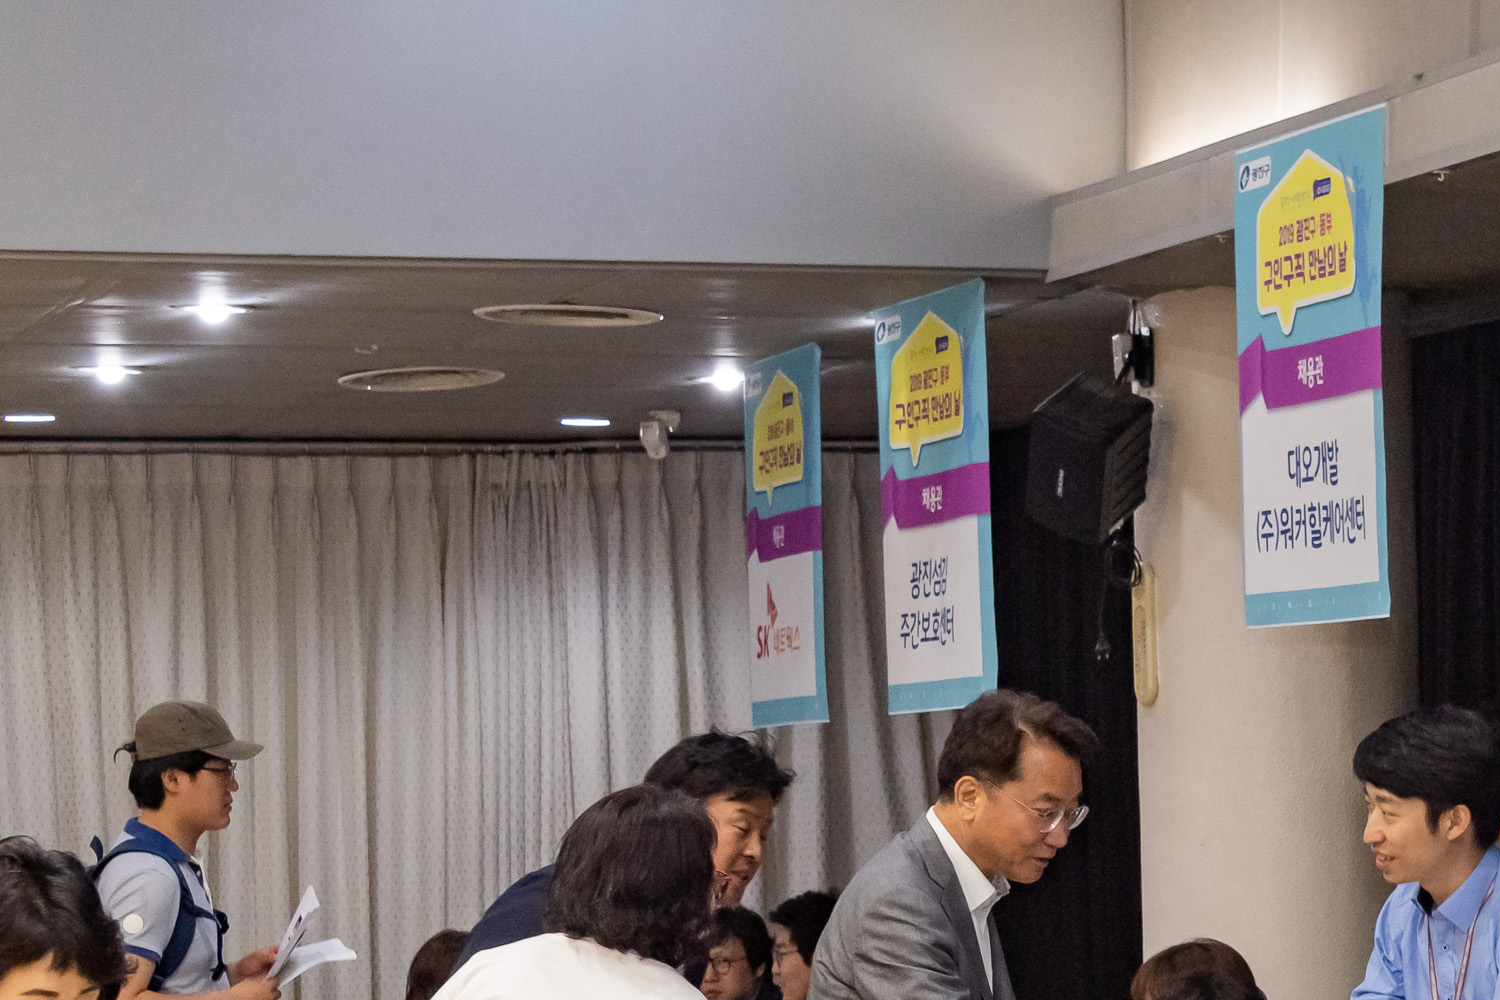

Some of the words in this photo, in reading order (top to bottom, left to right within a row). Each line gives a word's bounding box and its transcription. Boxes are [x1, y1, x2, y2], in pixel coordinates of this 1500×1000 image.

[1278, 223, 1294, 247] 2019
[1296, 216, 1316, 243] 광진구
[1319, 211, 1333, 237] 동부
[1264, 252, 1306, 292] 구인구직
[1308, 244, 1337, 281] 만남의
[1338, 241, 1348, 273] 날
[1297, 354, 1324, 389] 채용관
[895, 397, 930, 431] 구인구직
[1286, 438, 1340, 489] 대오개발
[922, 485, 943, 513] 채용관
[1256, 494, 1367, 553] (주)워커힐케어센터
[756, 625, 771, 660] SK
[900, 604, 955, 650] 주간보호센터
